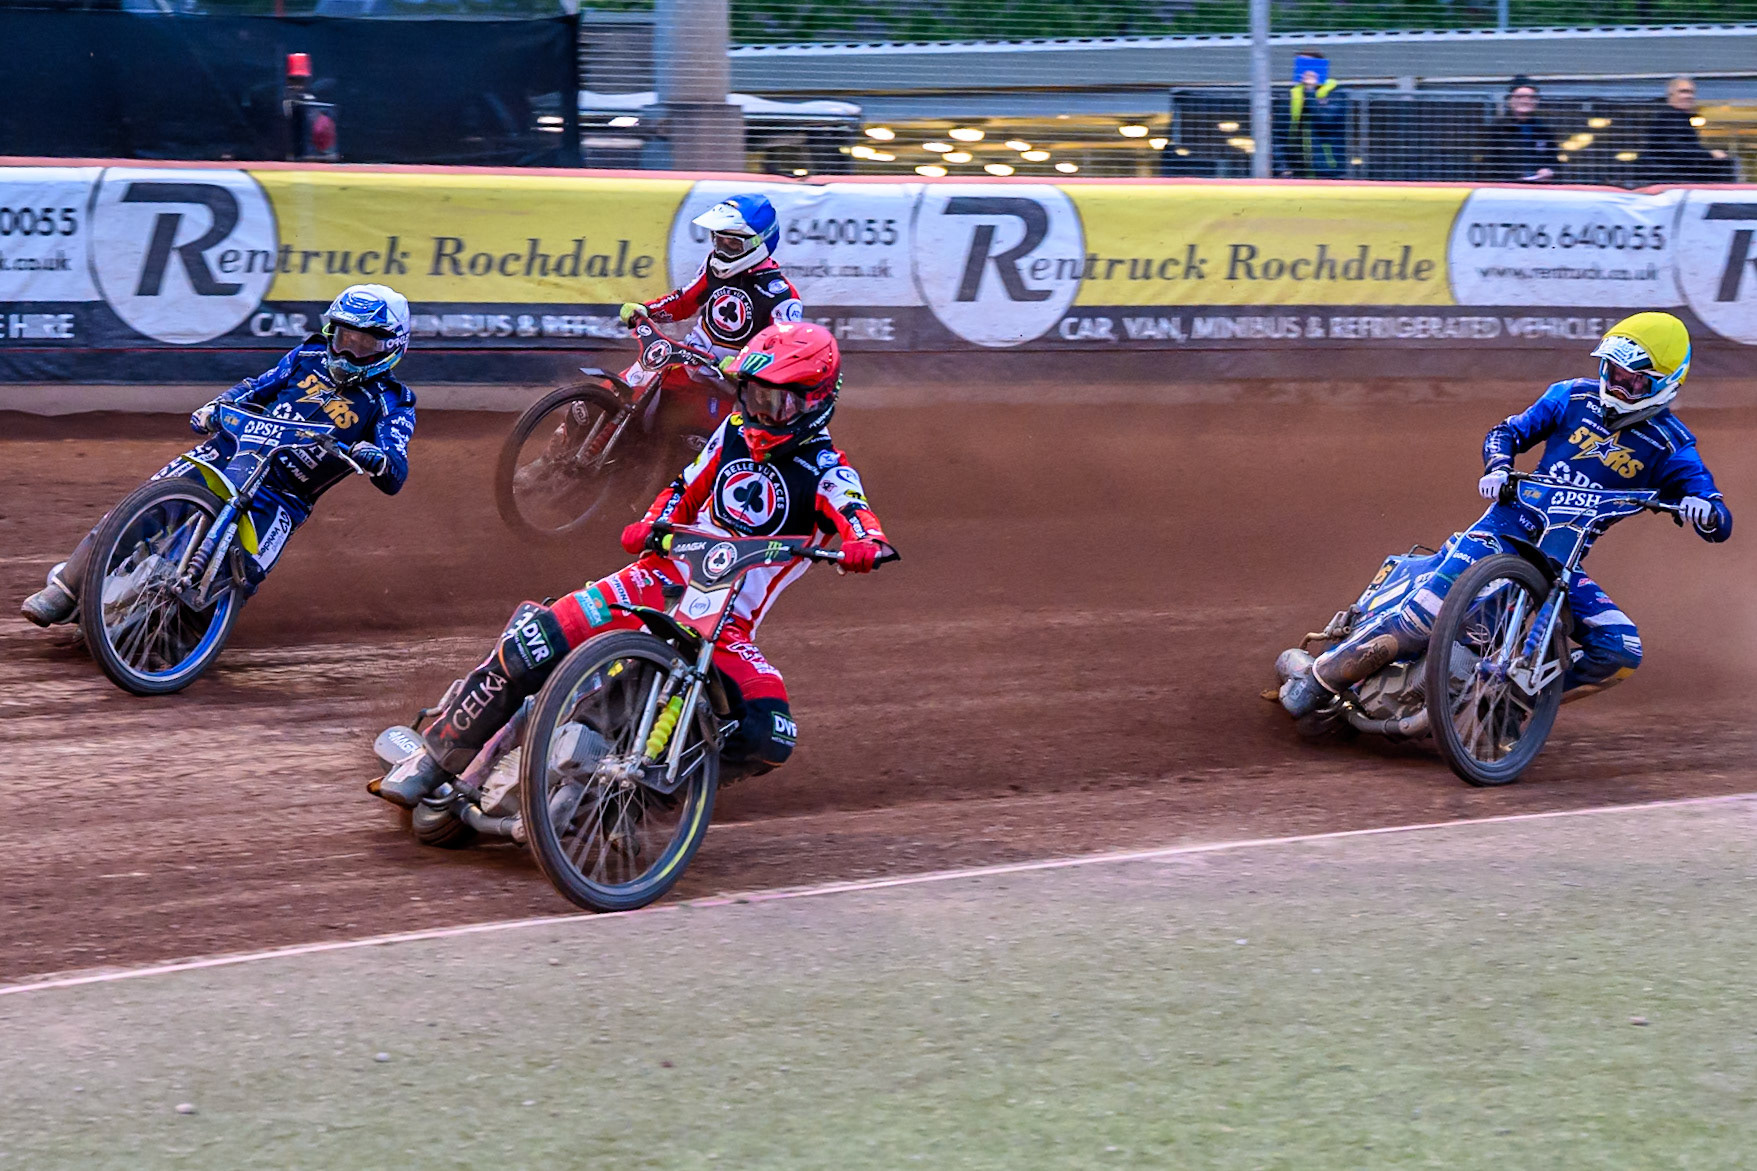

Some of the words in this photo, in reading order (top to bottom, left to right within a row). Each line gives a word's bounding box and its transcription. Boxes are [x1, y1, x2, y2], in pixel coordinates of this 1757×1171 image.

[120, 182, 409, 296] Rentruck
[427, 236, 655, 279] Rochdale
[944, 196, 1209, 302] Rentruck
[1225, 242, 1436, 282] Rochdale
[9, 313, 75, 339] HIRE
[835, 317, 896, 340] HIRE
[1304, 316, 1325, 338] &
[724, 463, 754, 477] BELLE
[758, 465, 776, 480] VUE
[773, 482, 785, 509] ACES
[1563, 491, 1602, 508] PSH
[522, 622, 550, 662] DVR
[452, 670, 509, 732] CELKA
